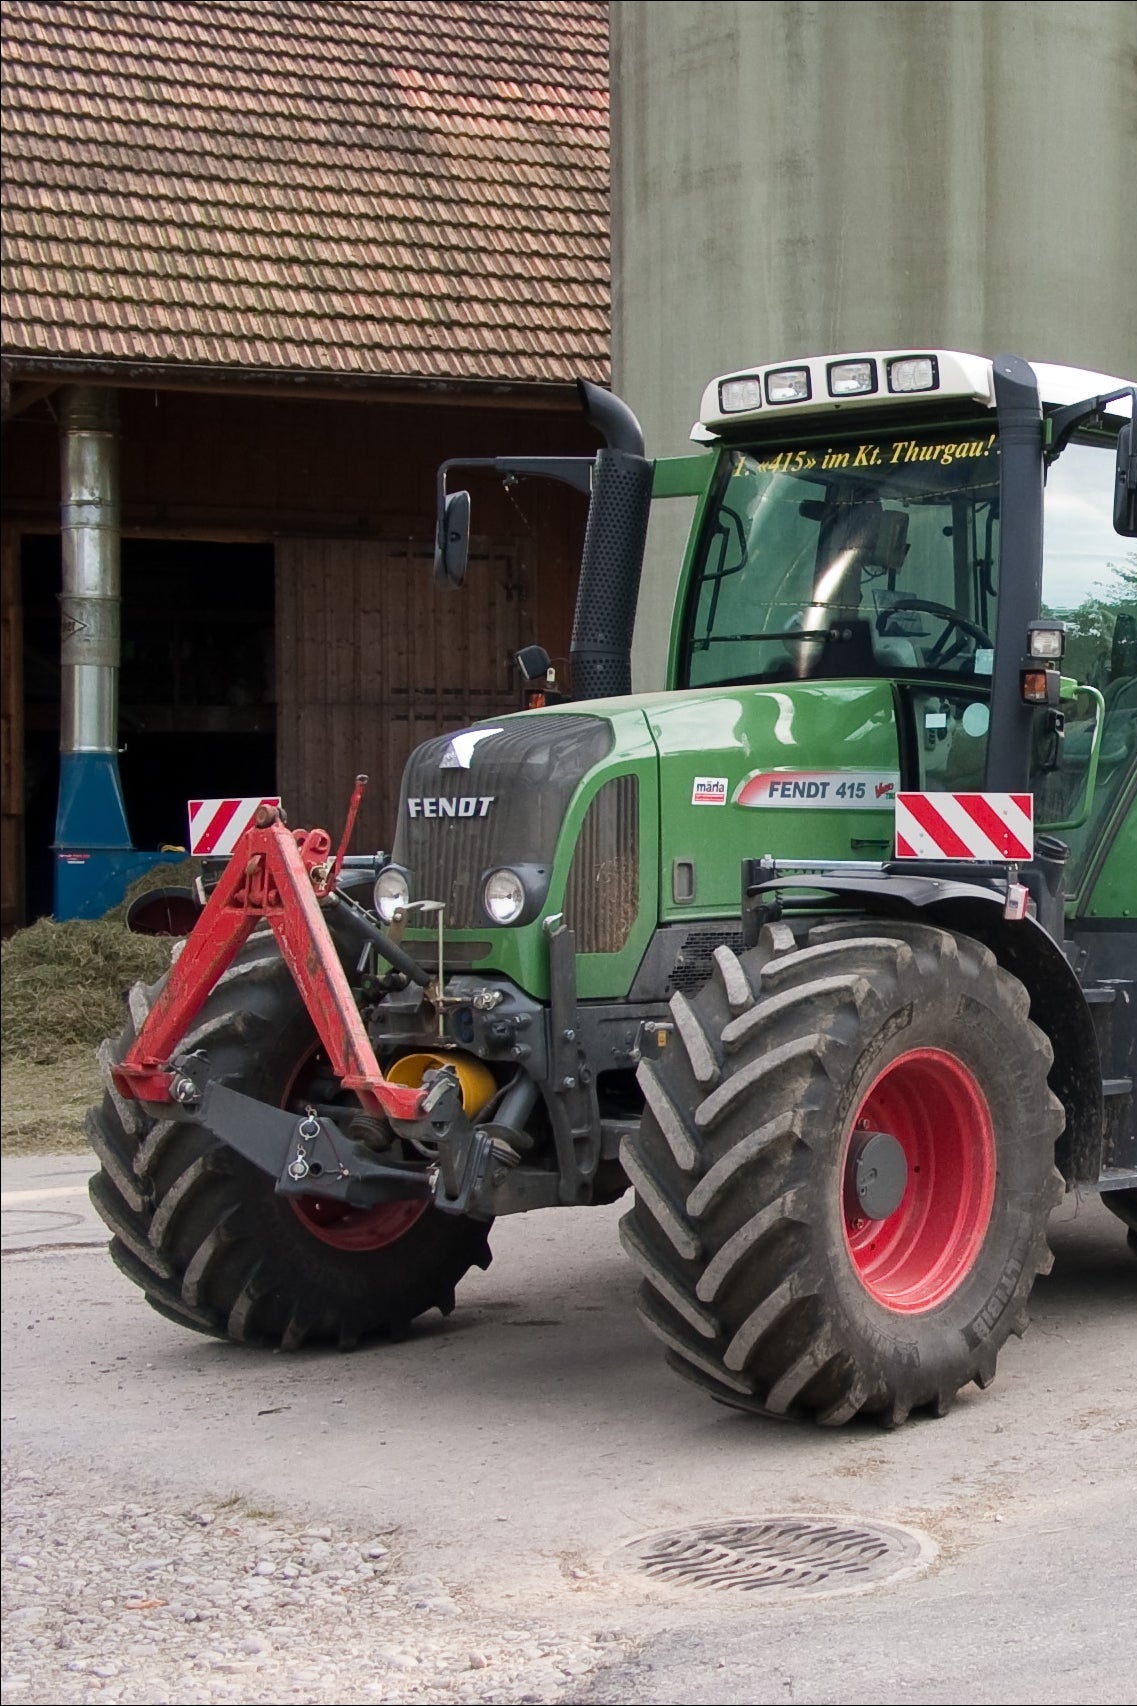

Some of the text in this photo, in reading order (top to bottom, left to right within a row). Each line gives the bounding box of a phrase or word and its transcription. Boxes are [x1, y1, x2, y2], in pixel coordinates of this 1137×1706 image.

[733, 456, 750, 477] 1.
[821, 448, 848, 469] im
[852, 444, 882, 468] Kt.
[889, 434, 996, 466] Thurgau!
[768, 781, 830, 799] FENDT
[835, 782, 866, 799] 415
[407, 796, 495, 818] FENDT
